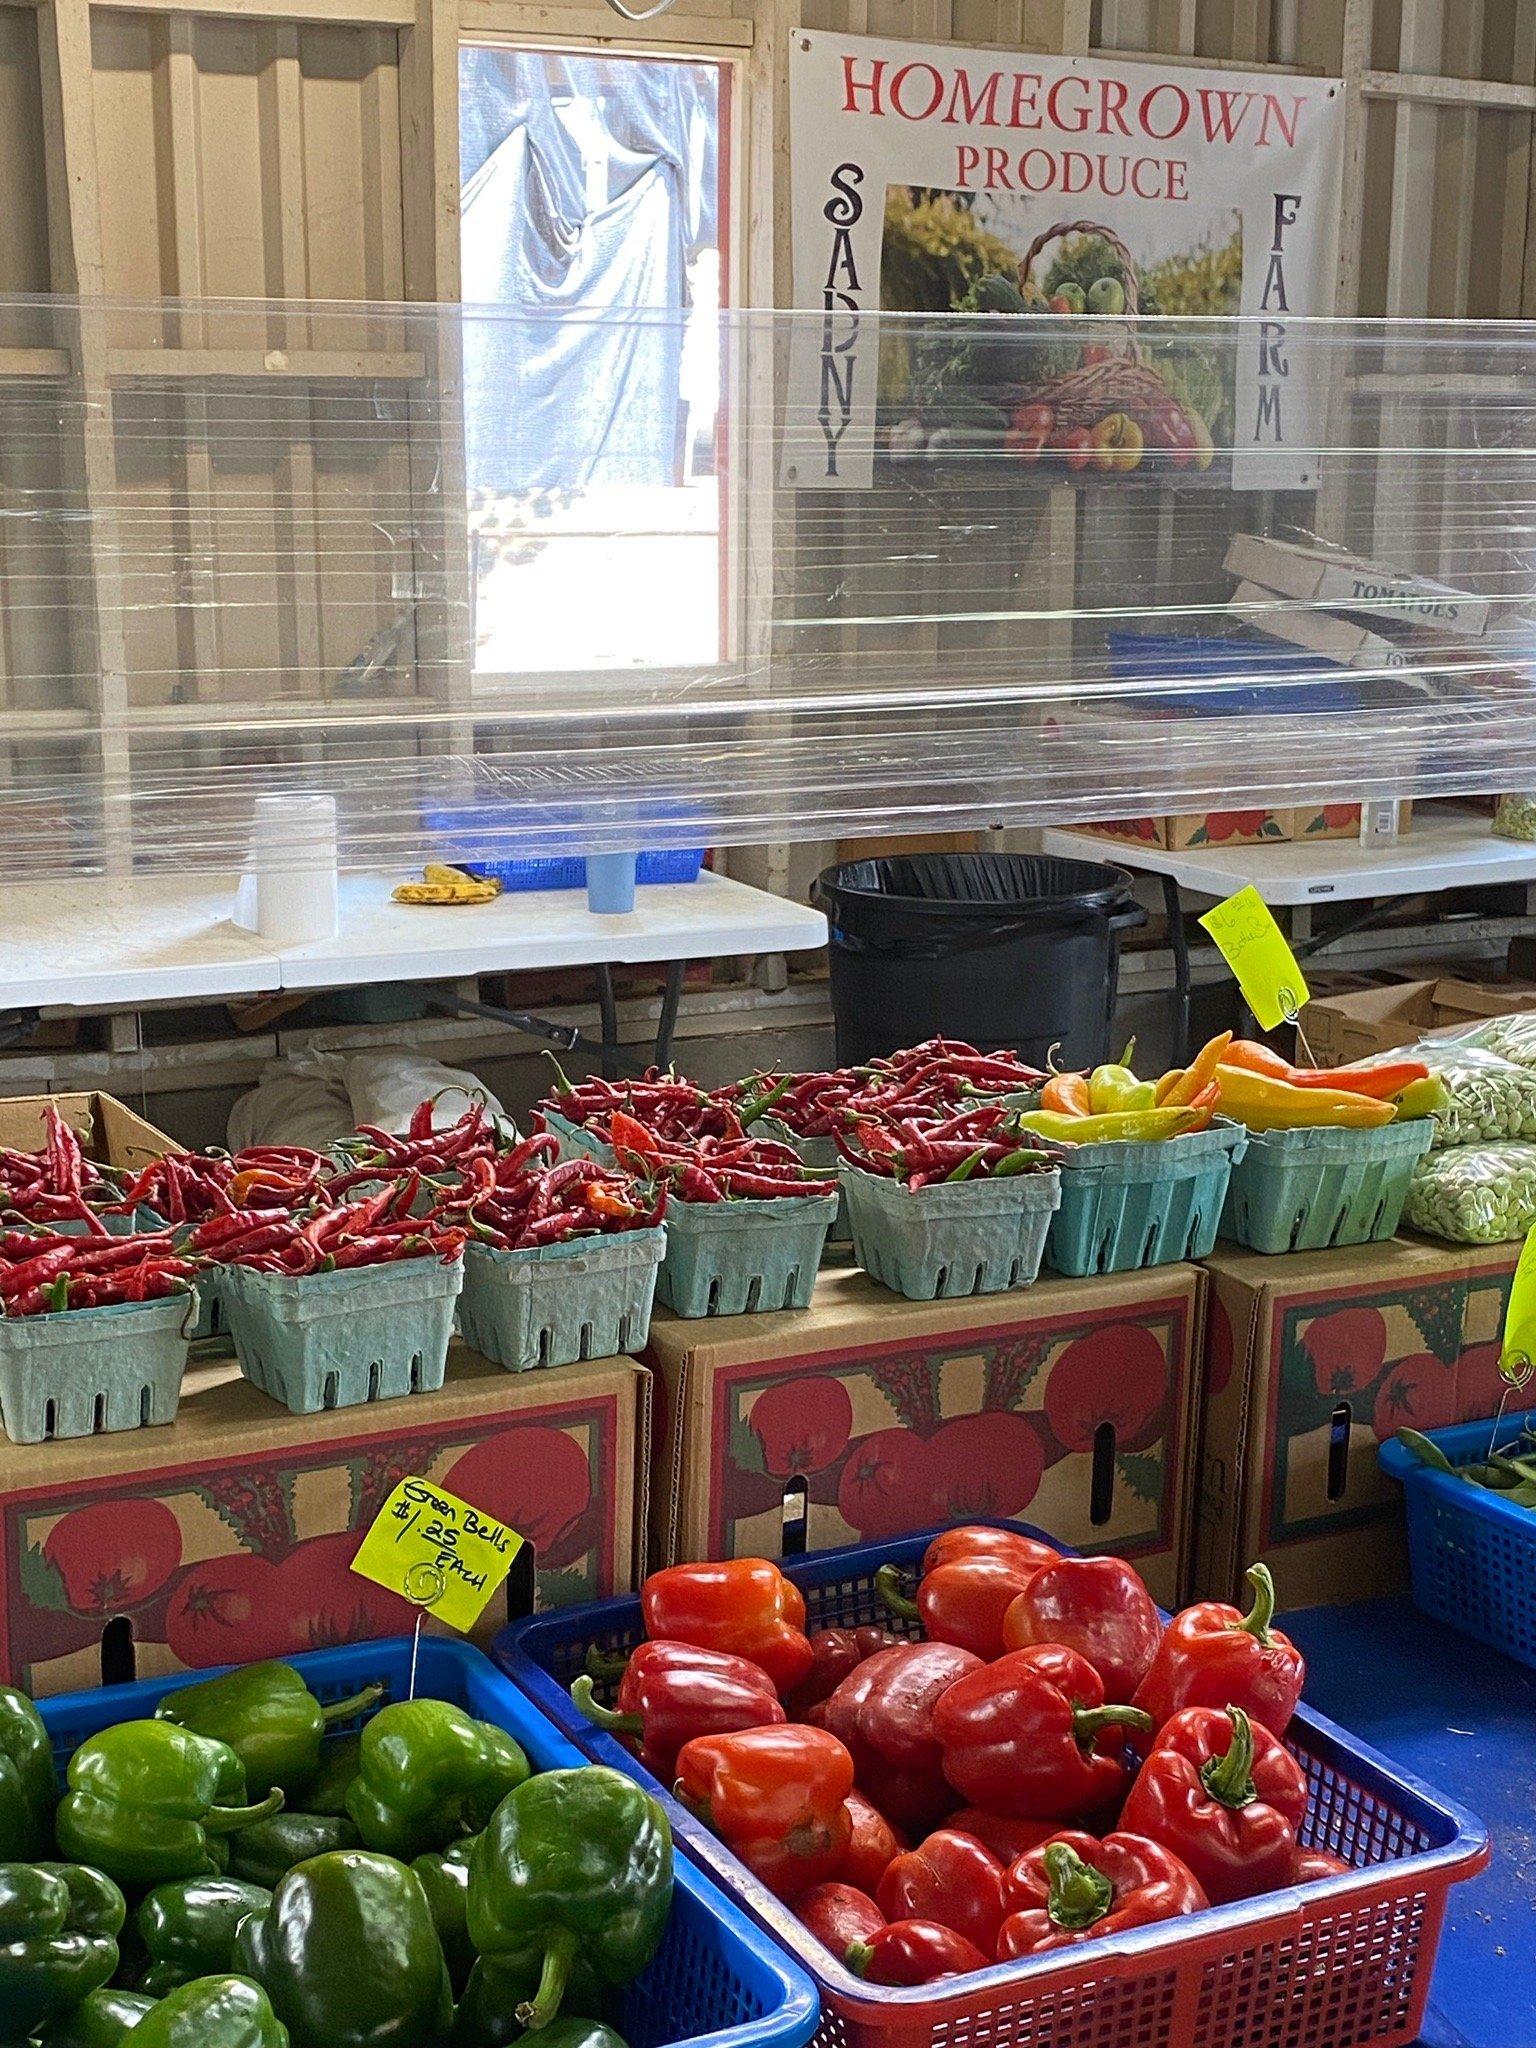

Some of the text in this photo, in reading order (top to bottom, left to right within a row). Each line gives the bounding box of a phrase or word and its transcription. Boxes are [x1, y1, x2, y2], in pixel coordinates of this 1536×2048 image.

[840, 55, 1307, 149] HOMEGROWN
[954, 144, 1190, 201] PRODUCE
[818, 162, 865, 477] SADNY
[1253, 193, 1302, 443] FARM
[391, 1499, 461, 1547] $1.25
[403, 1480, 511, 1553] Green Bells
[434, 1550, 488, 1592] EACH
